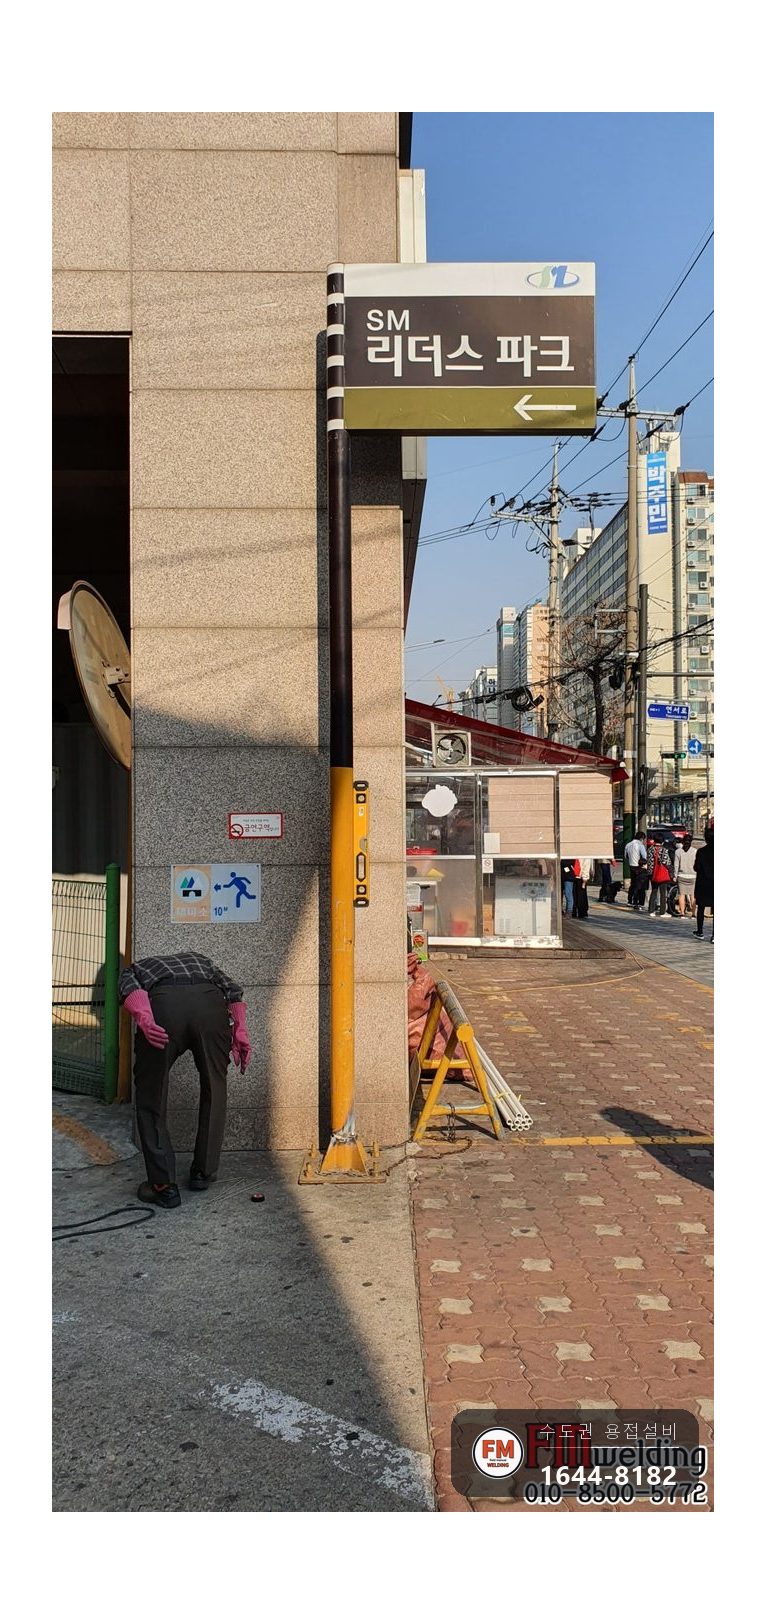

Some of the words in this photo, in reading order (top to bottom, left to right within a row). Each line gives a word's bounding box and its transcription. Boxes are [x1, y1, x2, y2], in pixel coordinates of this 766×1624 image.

[366, 309, 410, 331] SM
[367, 335, 483, 377] 리더스
[497, 335, 574, 377] 파크
[648, 465, 667, 523] 박주민
[666, 706, 687, 714] 연서로
